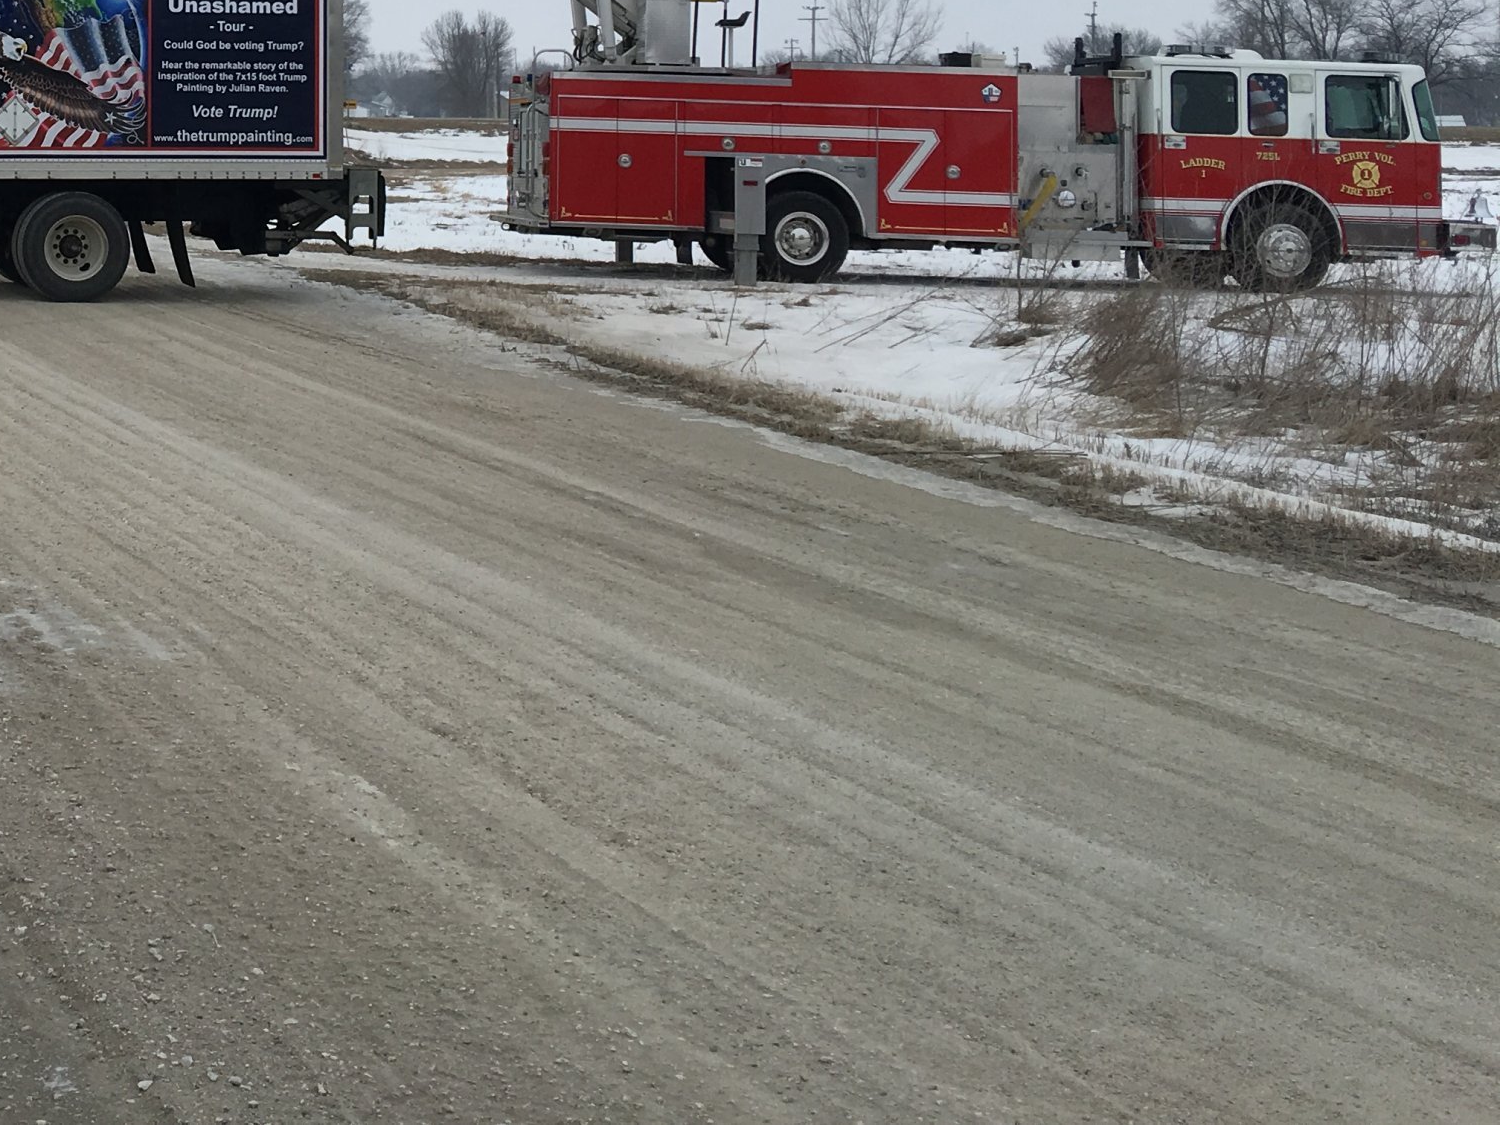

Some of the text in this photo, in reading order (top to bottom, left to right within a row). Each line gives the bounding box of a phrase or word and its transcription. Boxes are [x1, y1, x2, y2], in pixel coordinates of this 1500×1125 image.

[217, 21, 246, 32] Tour
[163, 40, 304, 52] Could God be voting Trump?
[161, 61, 304, 72] Hear the remarkable story of the
[208, 72, 217, 80] of
[219, 72, 233, 80] the
[235, 73, 257, 81] 7x15
[258, 72, 276, 81] foot
[278, 73, 307, 83] Trump
[176, 83, 289, 93] Painting by Julian Raven.
[192, 105, 278, 120] Vote Trump!
[153, 129, 313, 145] www.thetrumppainting.com
[1256, 151, 1281, 161] 725L
[1334, 151, 1397, 166] PERRY VOL.
[1180, 157, 1226, 170] LADDER
[1201, 169, 1206, 178] 1
[1363, 170, 1369, 179] 1
[1340, 183, 1395, 197] FIRE DEPT.
